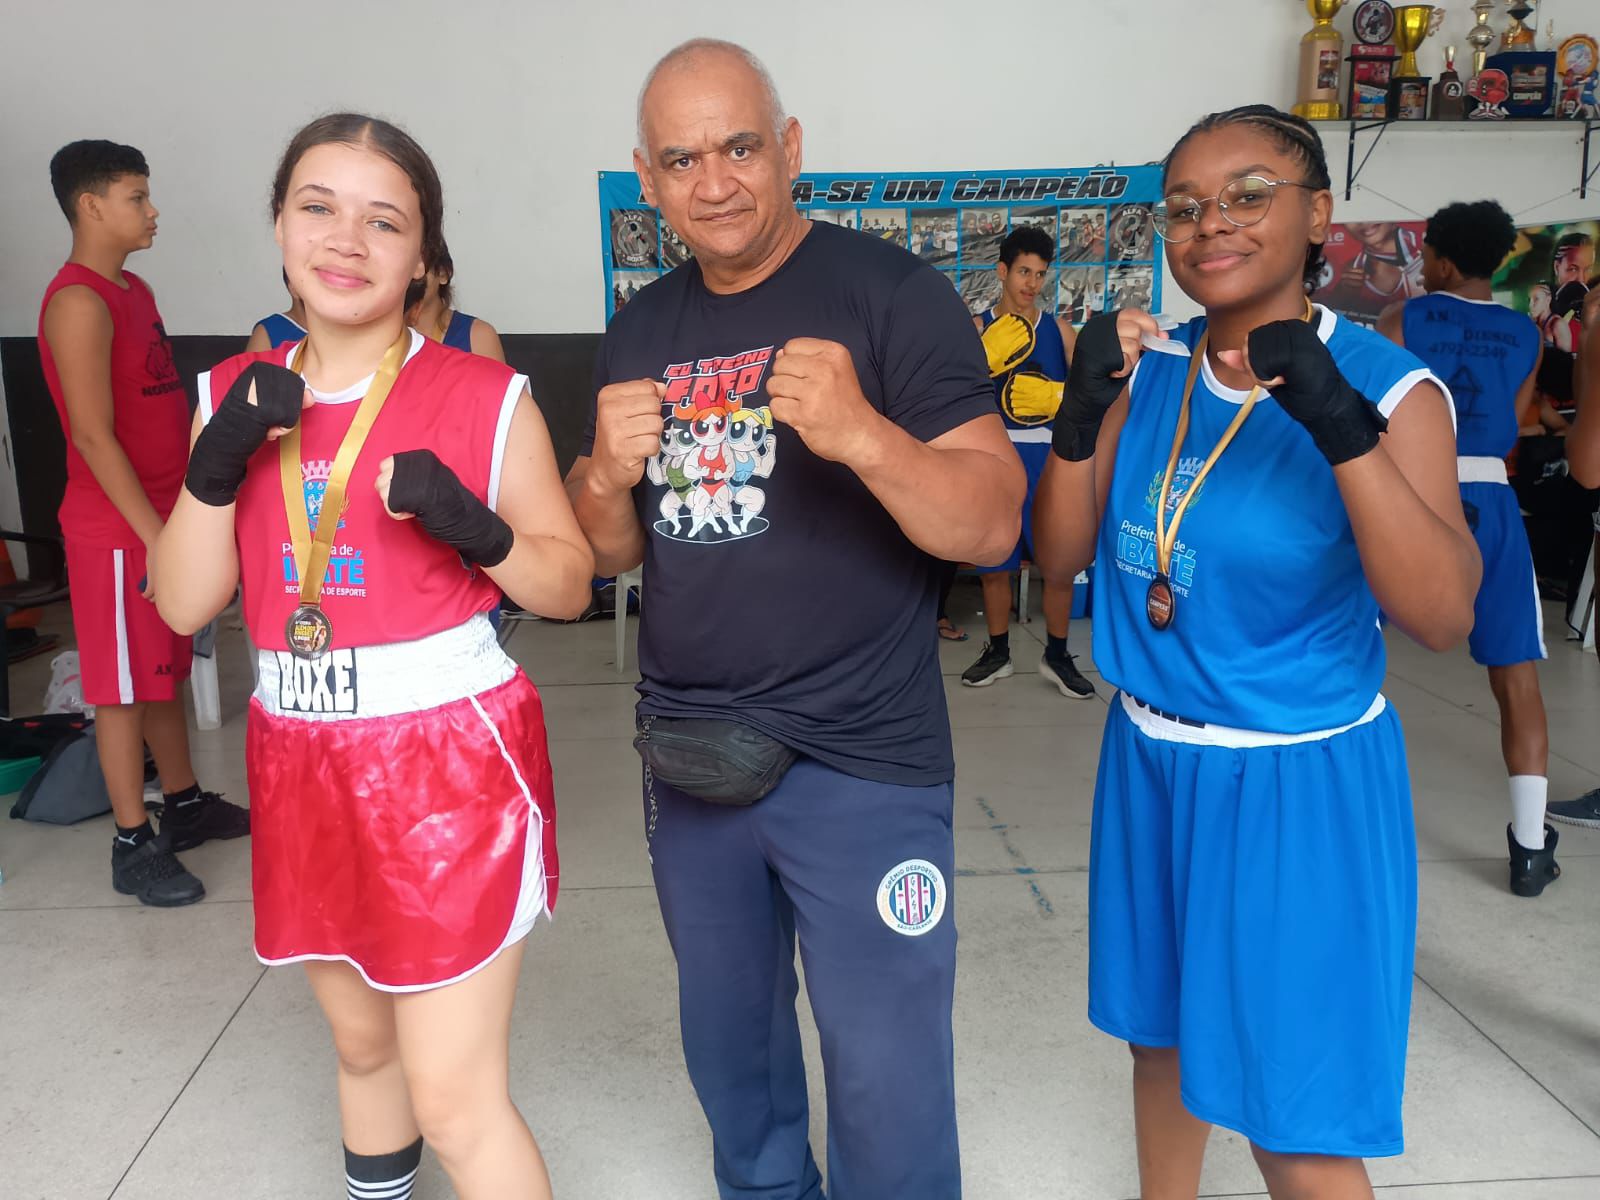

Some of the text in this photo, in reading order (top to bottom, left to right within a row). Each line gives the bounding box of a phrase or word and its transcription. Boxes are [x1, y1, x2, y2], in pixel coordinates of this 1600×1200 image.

[882, 179, 946, 203] UM
[952, 170, 1130, 202] CAMPEÃO
[665, 363, 694, 378] EU
[339, 544, 354, 556] de
[1120, 519, 1186, 553] Prefeit de
[283, 550, 365, 585] ITÉ
[1117, 531, 1197, 588] IBAÉ
[326, 586, 336, 596] DE
[336, 587, 367, 598] ESPORTE
[276, 649, 357, 713] BOXE
[885, 864, 938, 889] GRÊMIO DESPORTIVO
